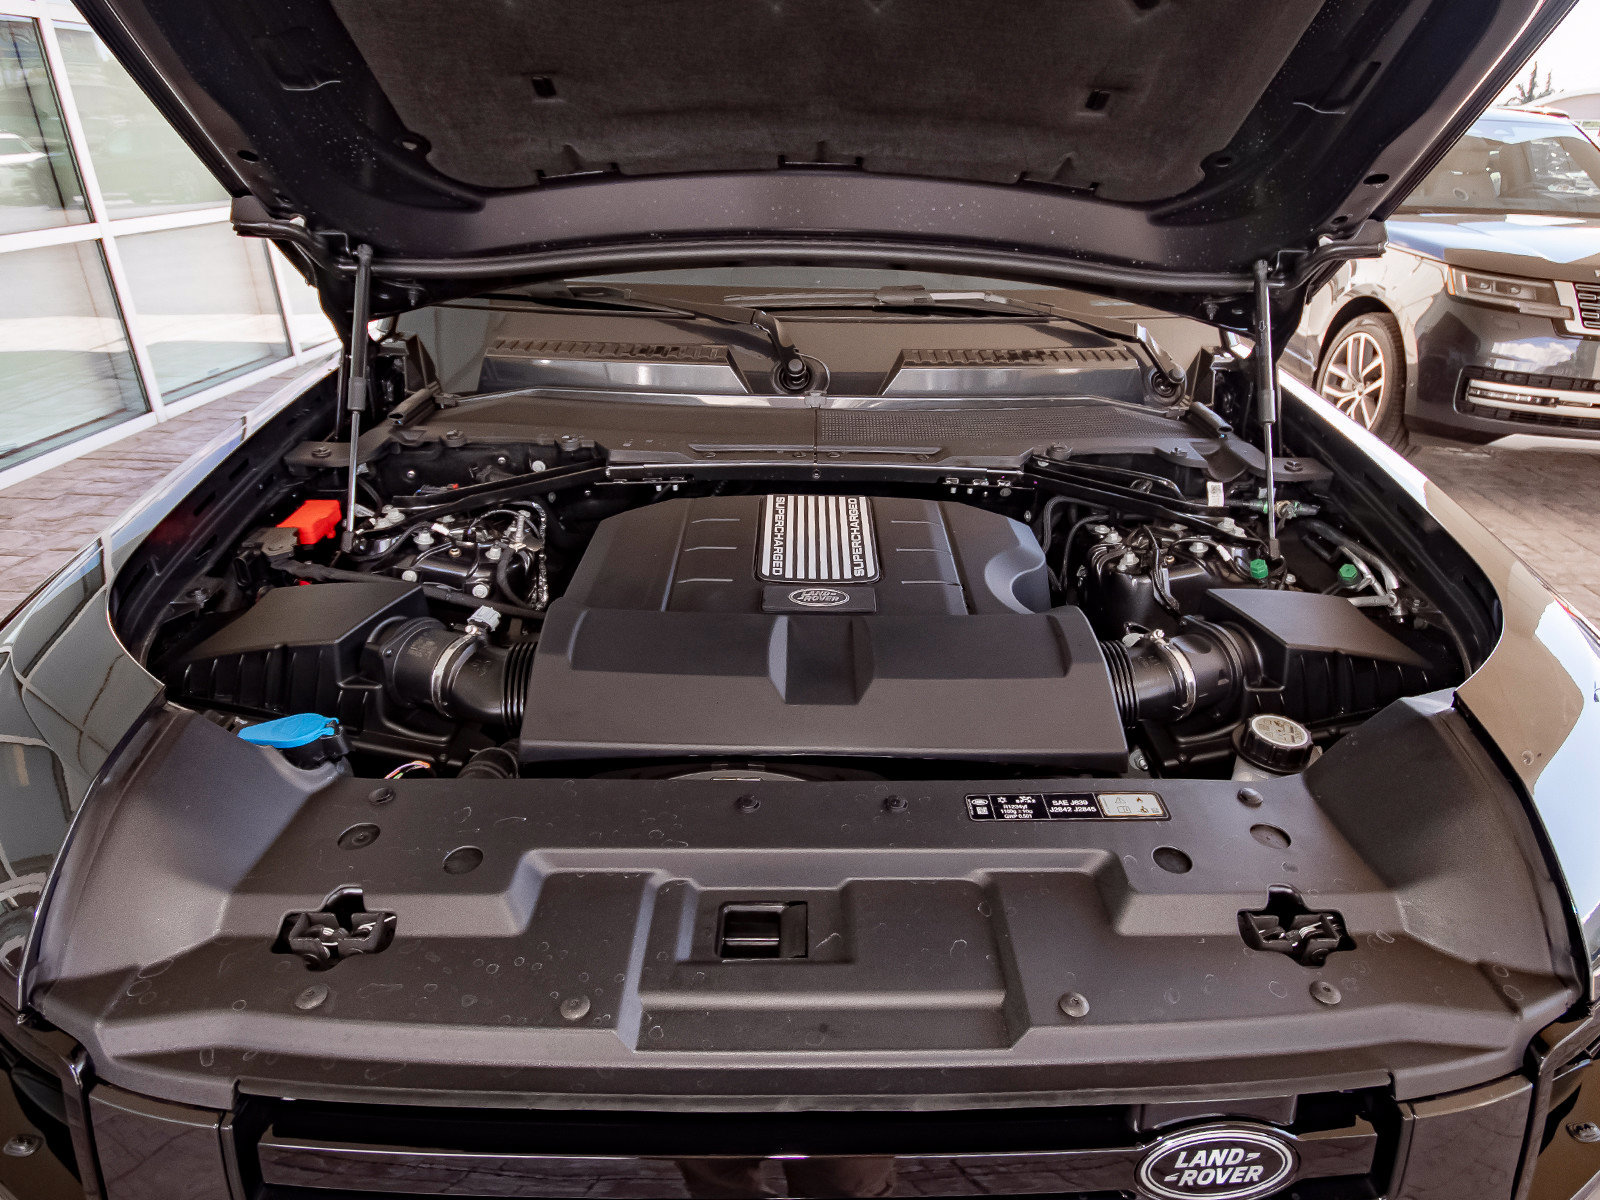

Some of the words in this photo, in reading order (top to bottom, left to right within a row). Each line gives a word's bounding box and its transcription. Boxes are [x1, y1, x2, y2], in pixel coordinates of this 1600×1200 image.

[771, 496, 786, 576] SUPERCHARGED
[847, 497, 865, 577] SUPERCHARGED
[1174, 1148, 1245, 1168] LAND
[1177, 1165, 1264, 1187] ROVER
